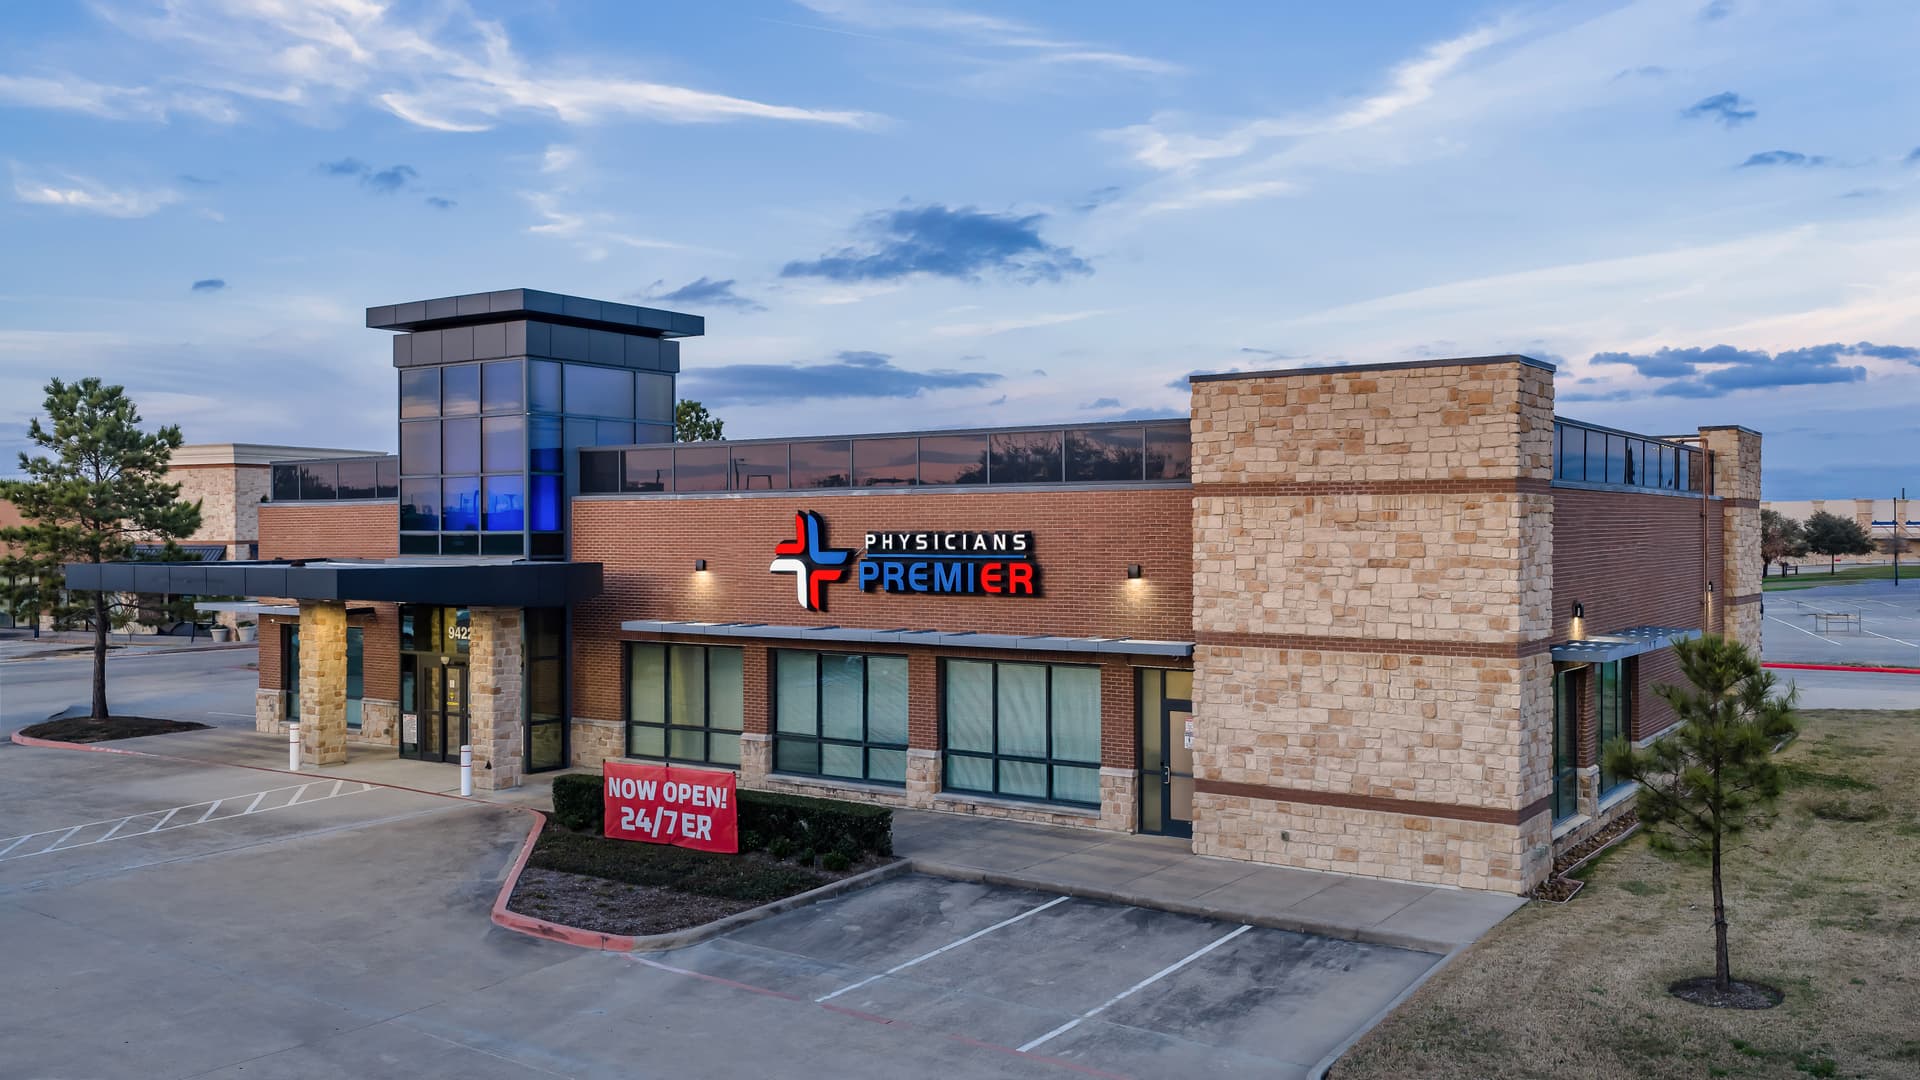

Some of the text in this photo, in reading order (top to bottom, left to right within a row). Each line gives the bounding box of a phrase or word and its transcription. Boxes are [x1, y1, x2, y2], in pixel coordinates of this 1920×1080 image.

[865, 534, 1026, 550] PHYSICIANS
[859, 561, 1033, 593] PREMIER
[608, 777, 727, 808] NOW OPEN!
[621, 806, 711, 840] 24/7 ER
